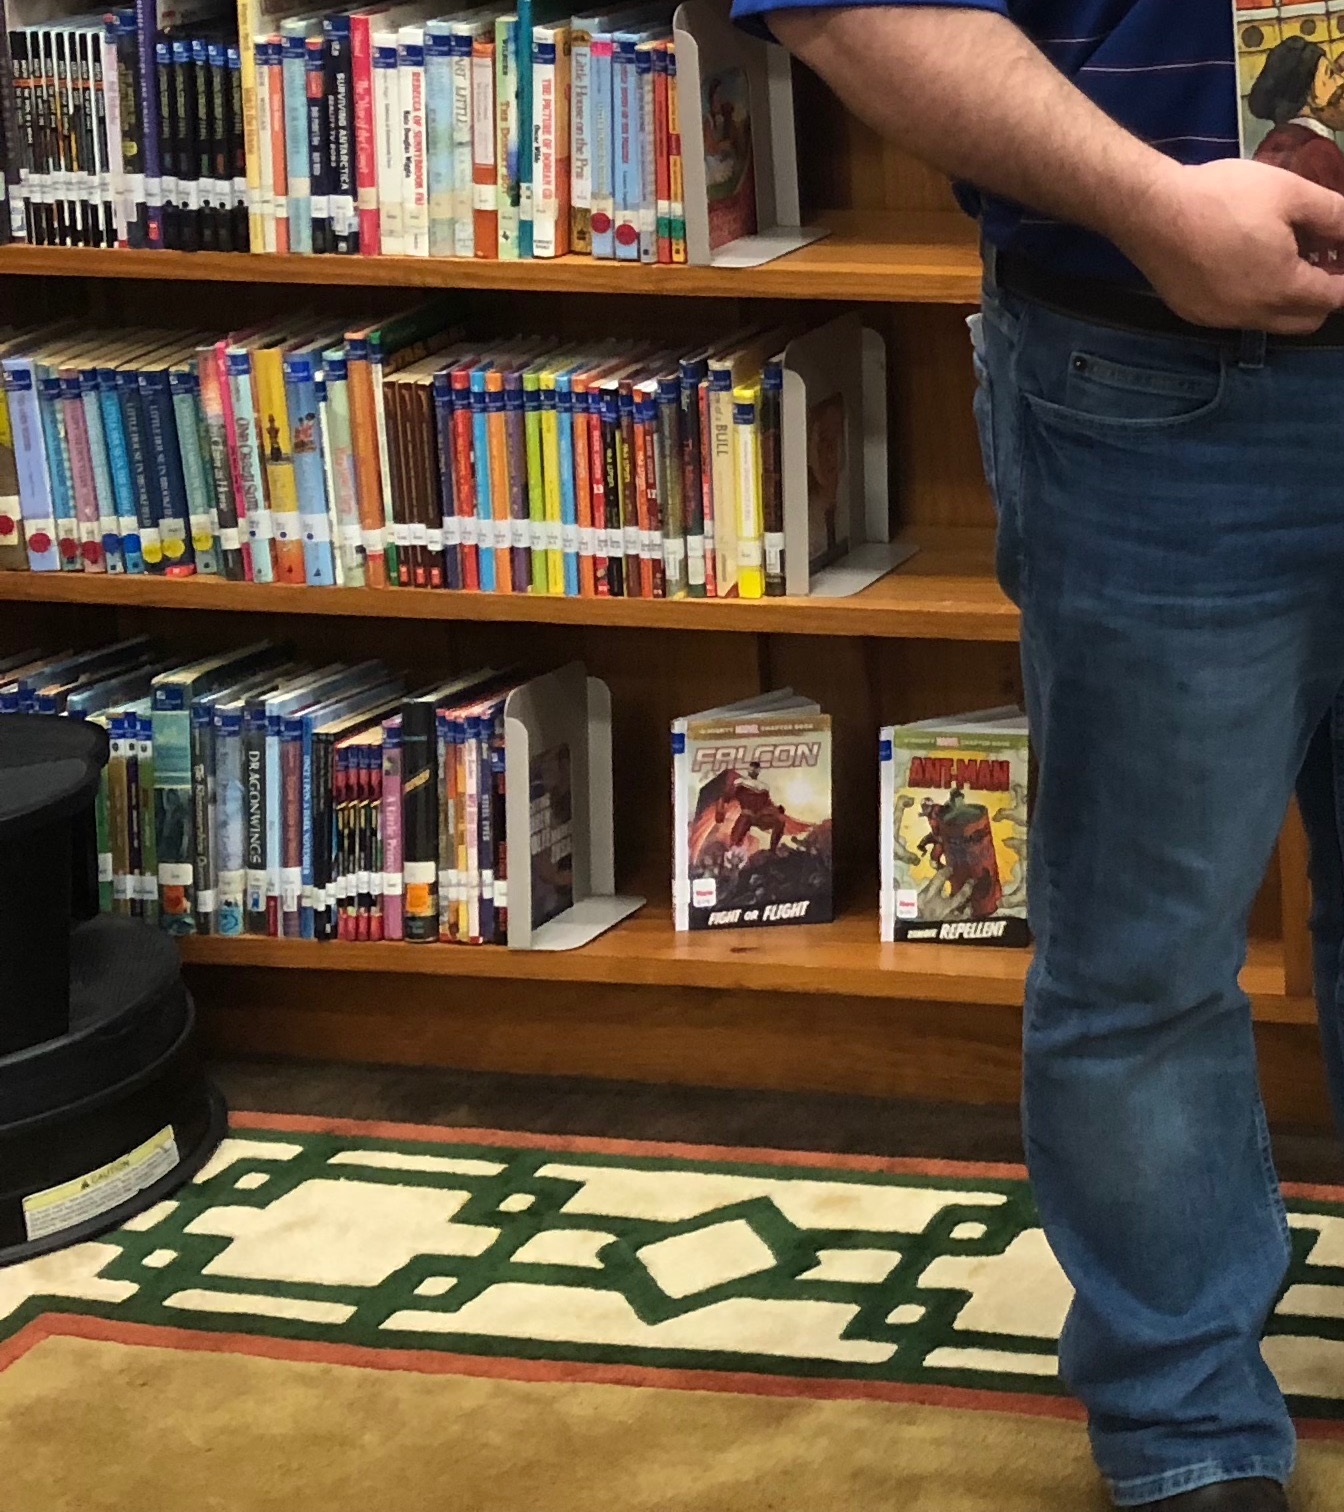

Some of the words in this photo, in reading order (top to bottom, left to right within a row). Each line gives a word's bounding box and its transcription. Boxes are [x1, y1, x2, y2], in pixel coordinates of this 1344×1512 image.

[575, 53, 588, 82] Little
[336, 73, 346, 126] SURVIVING
[412, 72, 421, 112] REBECCA
[543, 79, 552, 95] THE
[576, 85, 588, 120] House
[413, 116, 422, 127] OF
[542, 99, 552, 135] PICTURE
[576, 123, 587, 134] on
[339, 129, 349, 189] ANTARCTICA
[414, 130, 424, 189] SUNNYBROOK
[543, 138, 552, 151] OF
[576, 136, 588, 155] the
[403, 156, 412, 178] Wiggin
[543, 153, 552, 185] DORIAN
[126, 403, 138, 431] LITTLE
[692, 741, 821, 773] FALCON
[907, 756, 1010, 791] ANT-MAN
[248, 751, 261, 863] DRAGONWINGS
[386, 806, 397, 836] Little
[302, 833, 311, 875] NOVEMBER
[386, 839, 397, 873] Prince
[708, 909, 742, 926] FIGHT
[743, 909, 759, 921] OR
[762, 900, 810, 921] FLIGHT
[939, 921, 1007, 940] REPELLENT
